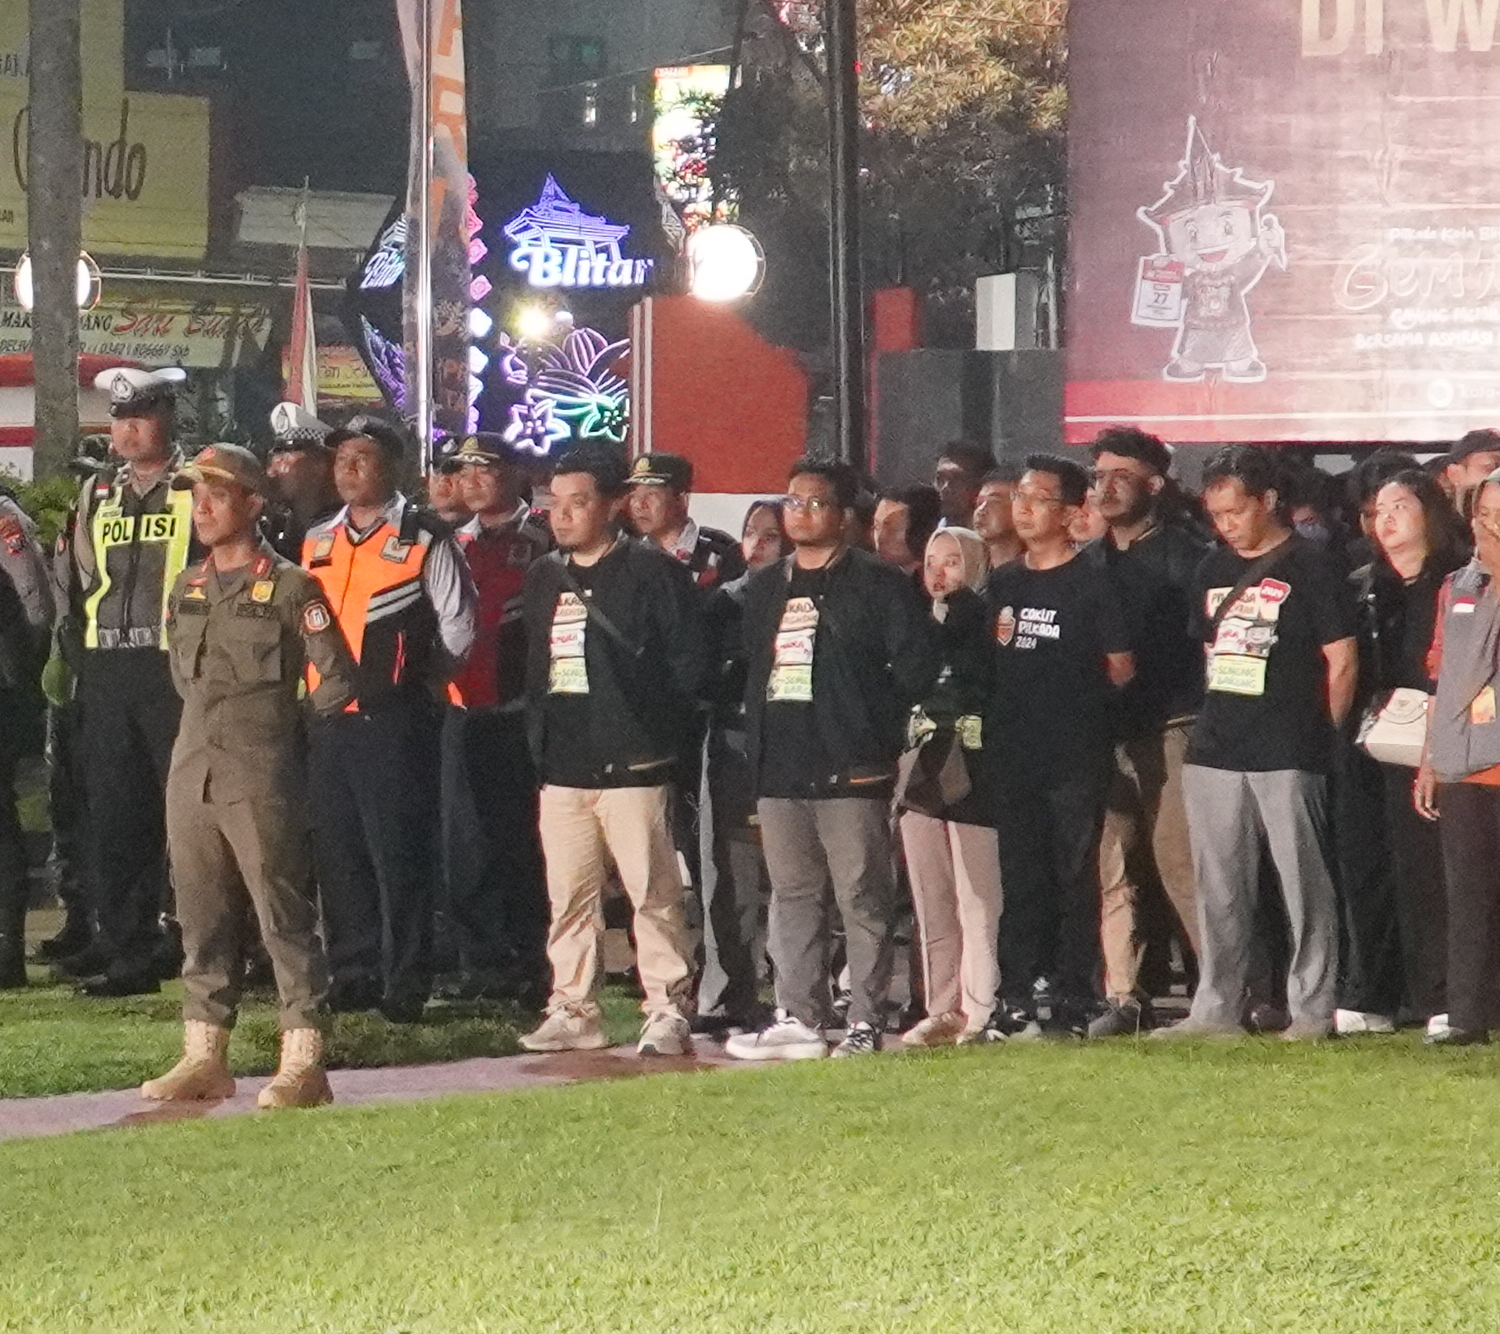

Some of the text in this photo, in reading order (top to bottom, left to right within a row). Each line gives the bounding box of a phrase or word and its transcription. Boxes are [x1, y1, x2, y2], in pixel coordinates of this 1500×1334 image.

[510, 246, 654, 288] Blitar
[1153, 291, 1169, 305] 27
[1020, 607, 1057, 623] COKLIT
[1018, 620, 1060, 640] PILKADA
[1015, 635, 1038, 649] 2024
